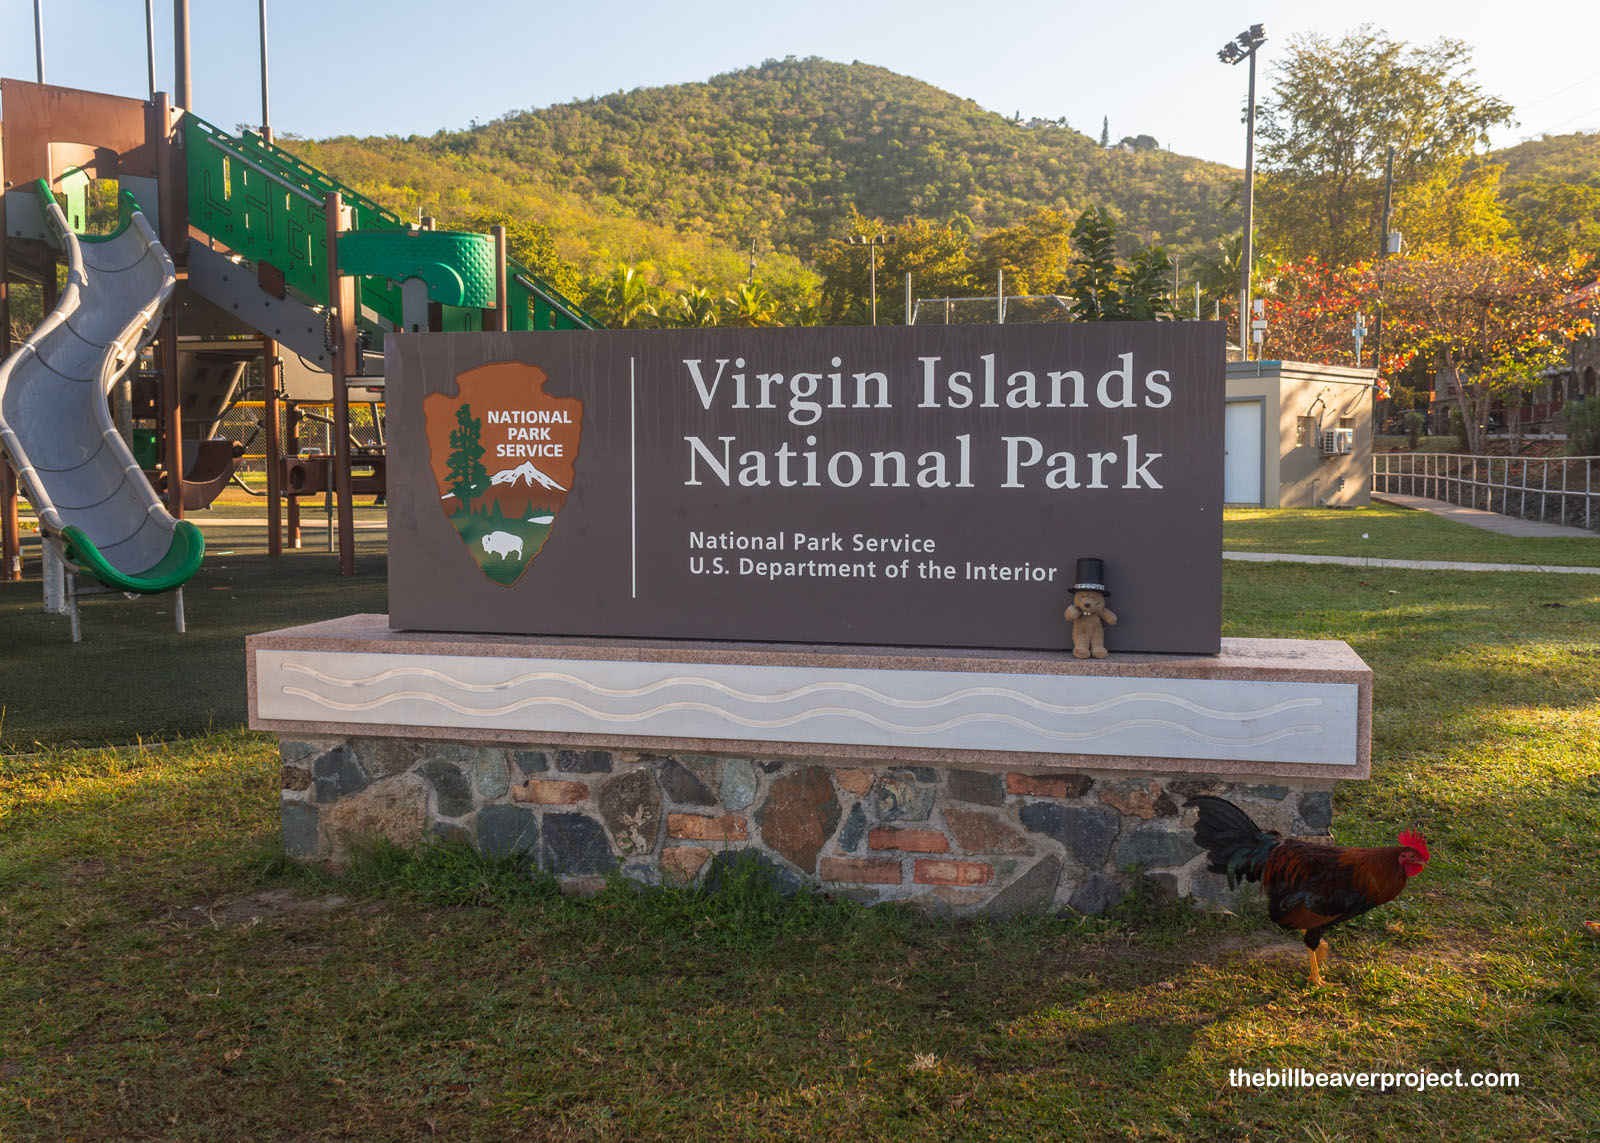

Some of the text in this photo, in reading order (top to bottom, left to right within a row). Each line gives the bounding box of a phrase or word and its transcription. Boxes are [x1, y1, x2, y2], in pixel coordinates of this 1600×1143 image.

[682, 351, 1173, 426] Virgin Islands
[486, 410, 573, 424] NATIONAL
[507, 427, 551, 441] PARK
[496, 443, 564, 458] SERVICE
[683, 433, 1165, 490] National Park
[689, 530, 936, 553] National Park Service
[689, 556, 1058, 583] U.S. Department of the Interior
